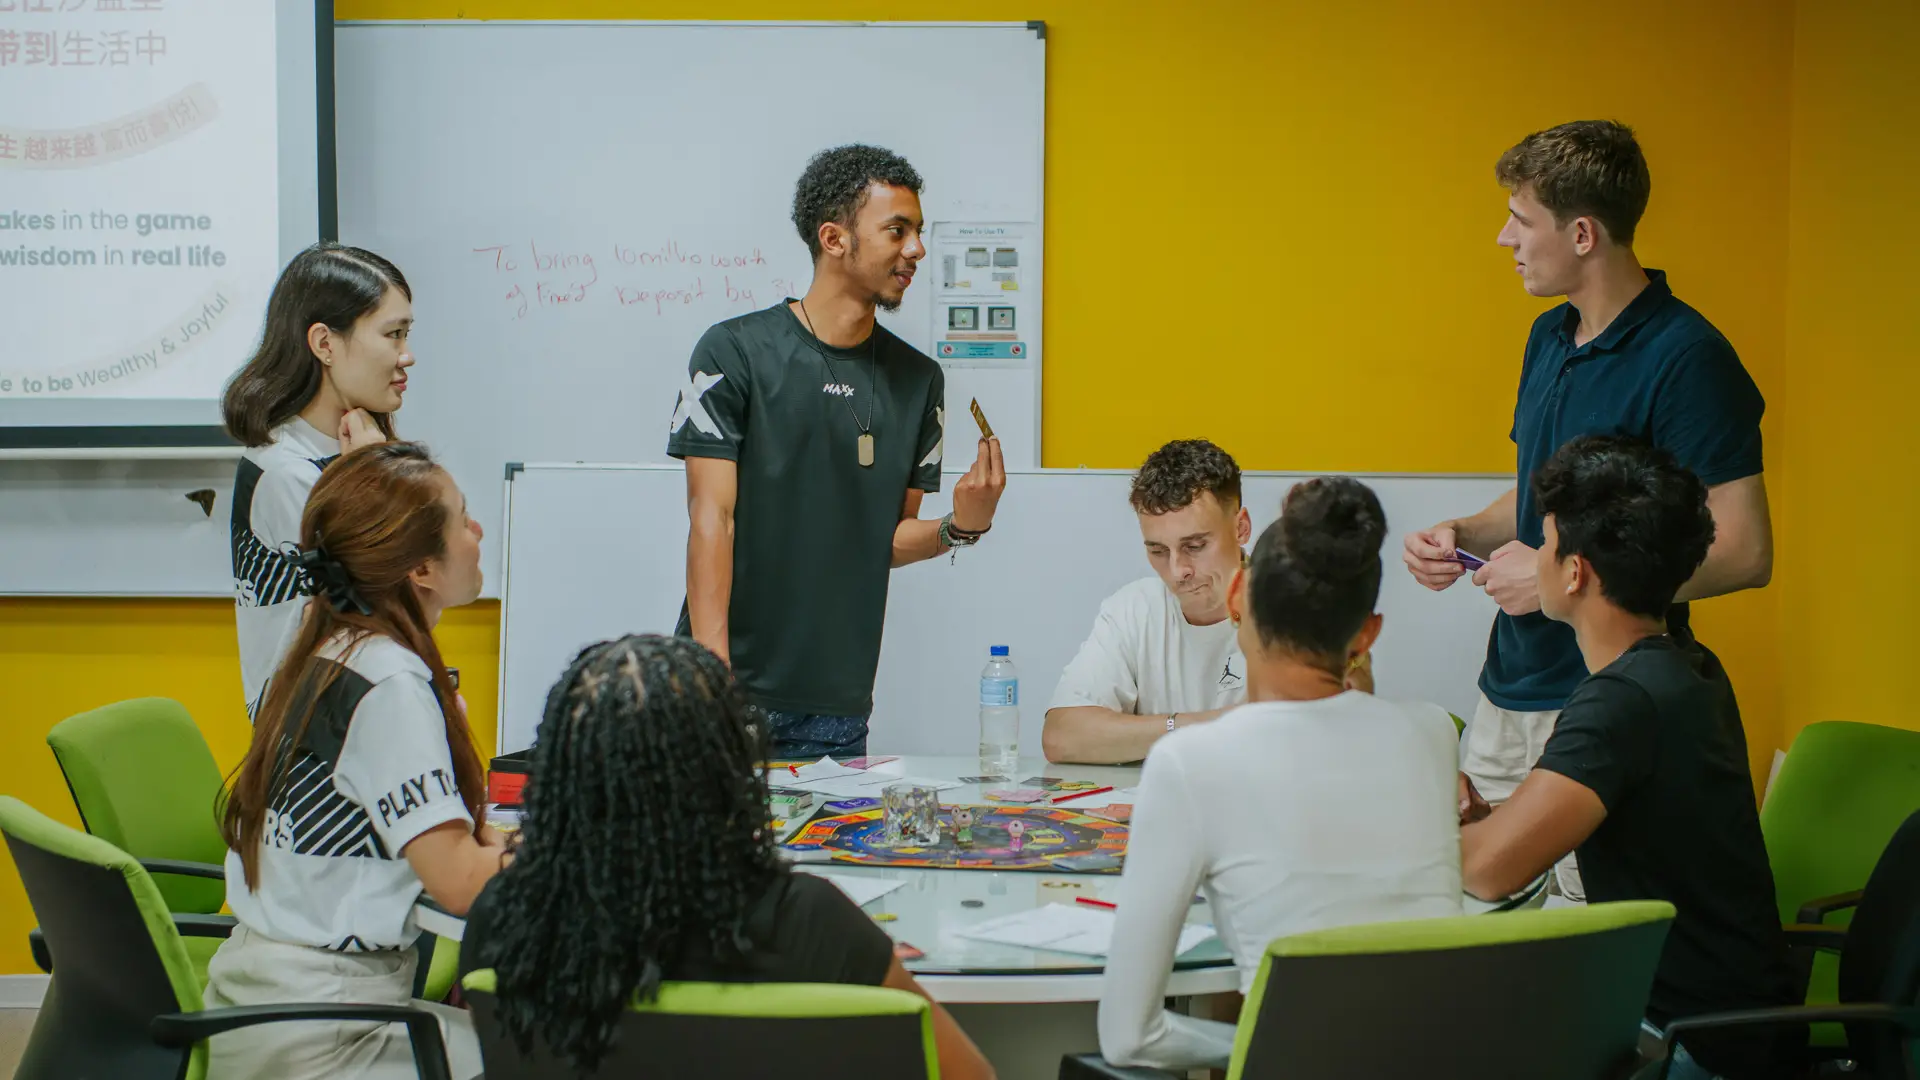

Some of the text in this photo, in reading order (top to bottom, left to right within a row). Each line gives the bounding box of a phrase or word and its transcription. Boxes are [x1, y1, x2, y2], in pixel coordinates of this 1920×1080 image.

[0, 209, 211, 236] akes in the game
[0, 244, 226, 267] wisdom in real life
[473, 244, 517, 273] To
[531, 238, 597, 286] bring
[710, 246, 768, 268] worth
[725, 276, 756, 310] by
[23, 376, 42, 393] to
[49, 375, 73, 391] be
[77, 349, 159, 389] Wealthy
[162, 337, 176, 356] &
[180, 292, 229, 344] Joyful
[377, 773, 429, 828] PLAY
